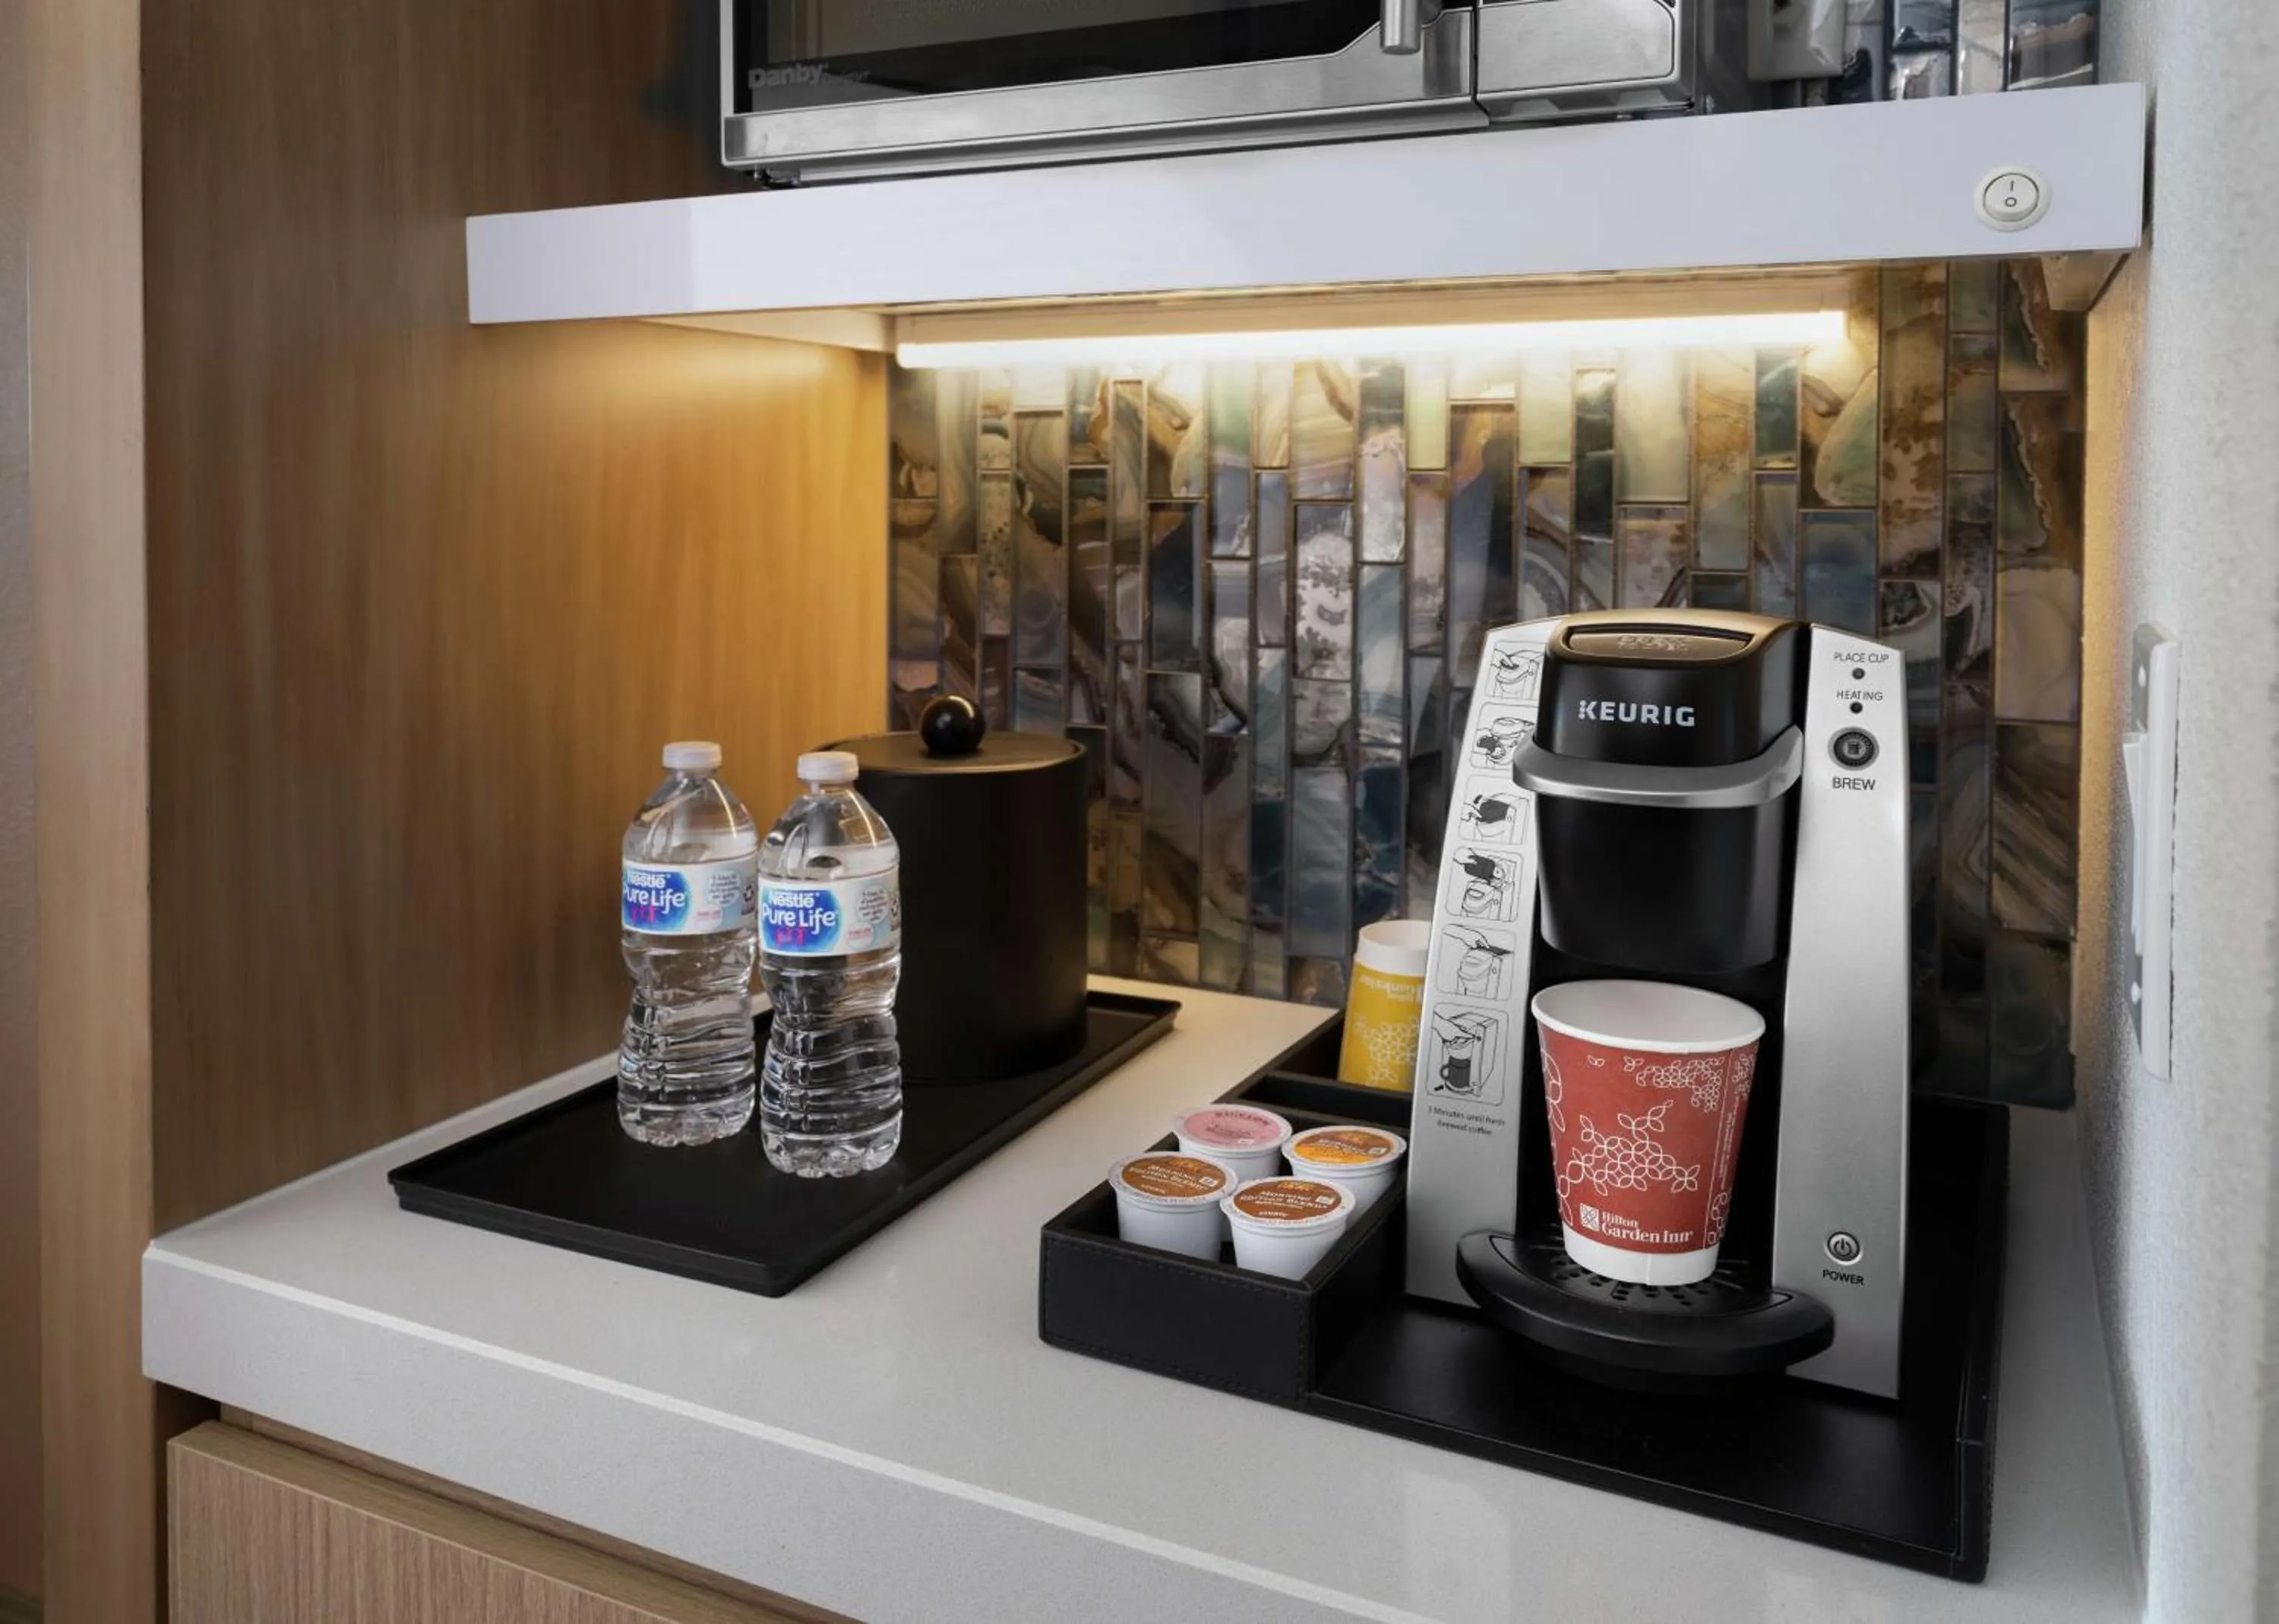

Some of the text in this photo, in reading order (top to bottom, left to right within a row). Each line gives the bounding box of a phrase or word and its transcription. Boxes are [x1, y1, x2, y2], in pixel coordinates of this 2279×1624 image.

[748, 63, 823, 89] Danby
[1834, 652, 1889, 663] PLACE CUP
[1836, 690, 1883, 701] HEATING
[1579, 700, 1696, 727] KEURIG
[1832, 776, 1876, 791] BREW
[651, 888, 685, 915] Life
[762, 902, 796, 927] Pure
[798, 907, 836, 936] Life
[1601, 1211, 1639, 1227] Hilton
[1601, 1222, 1690, 1243] Garden Inn
[1823, 1269, 1864, 1285] POWER
